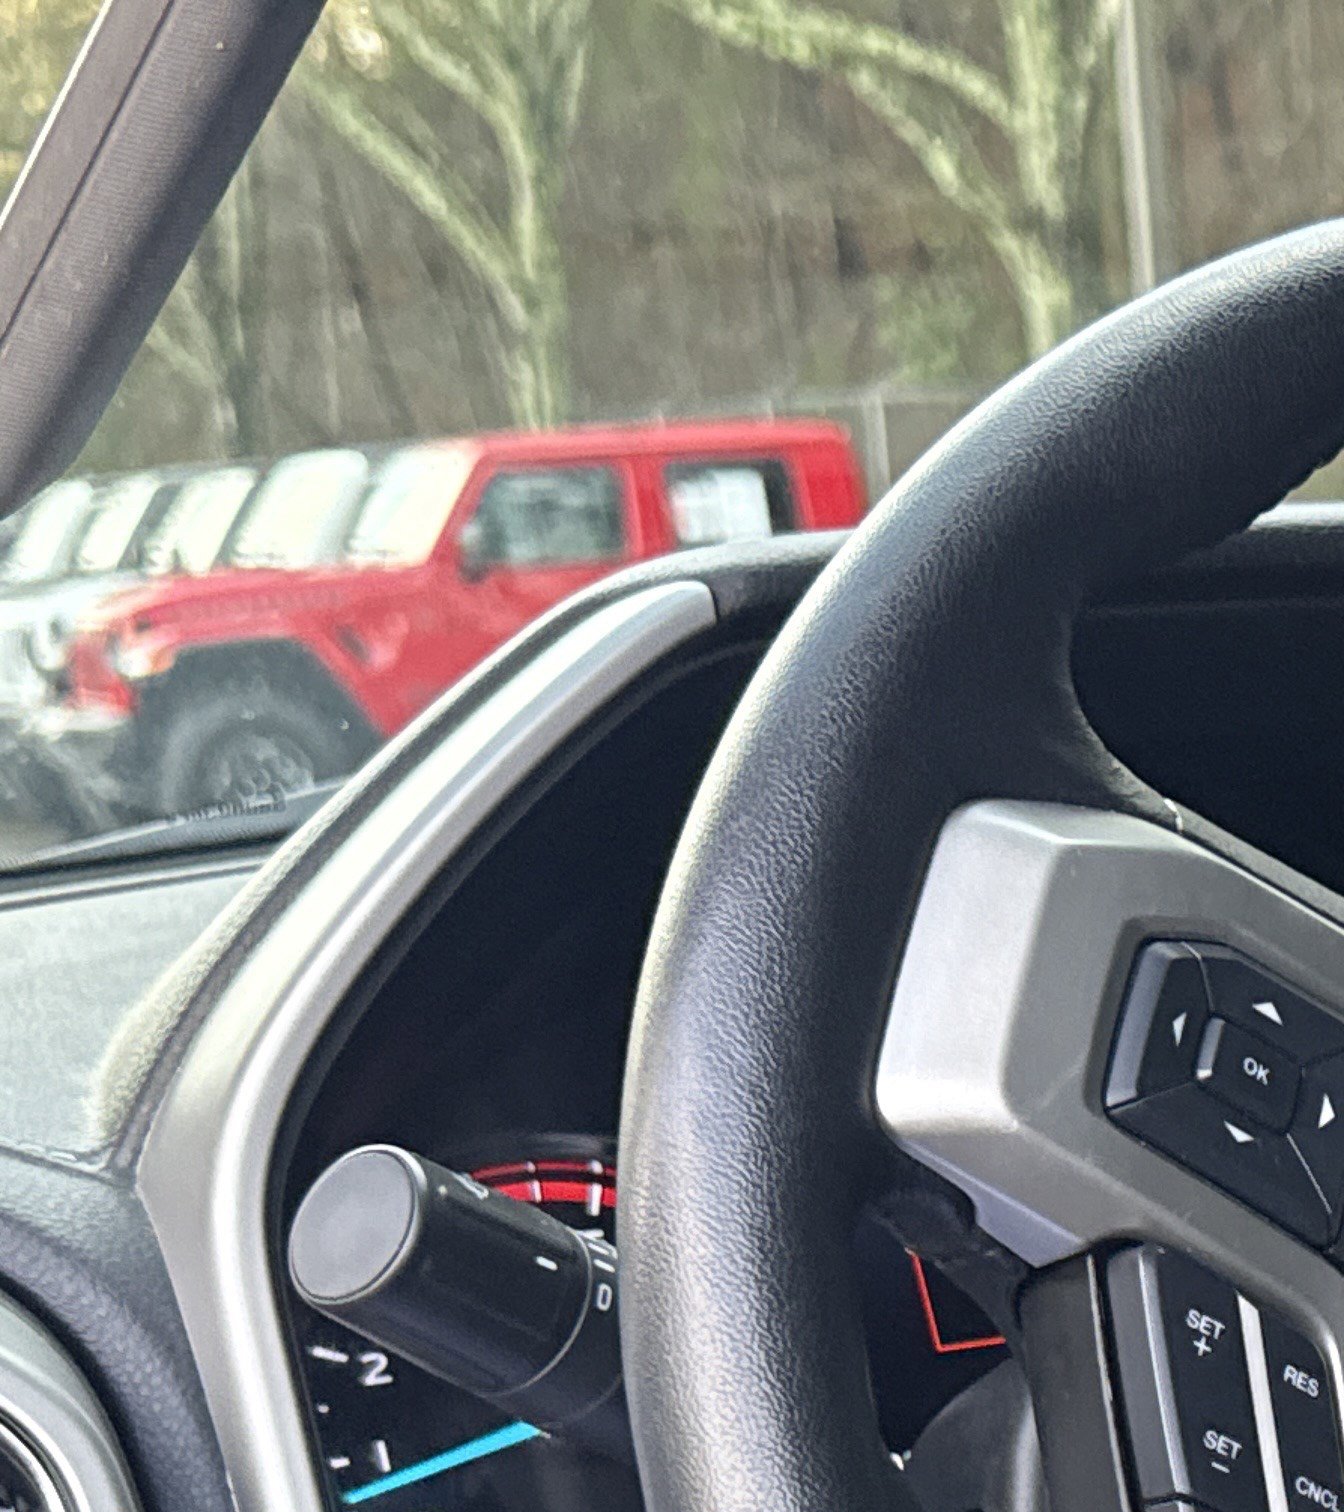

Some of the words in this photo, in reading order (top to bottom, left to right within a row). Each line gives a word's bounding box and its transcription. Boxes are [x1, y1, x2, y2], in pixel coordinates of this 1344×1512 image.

[1243, 1057, 1269, 1085] OK
[1185, 1308, 1226, 1341] SET
[359, 1352, 393, 1386] 2
[1283, 1364, 1319, 1397] RES
[375, 1440, 391, 1473] 1
[1203, 1430, 1242, 1460] SET
